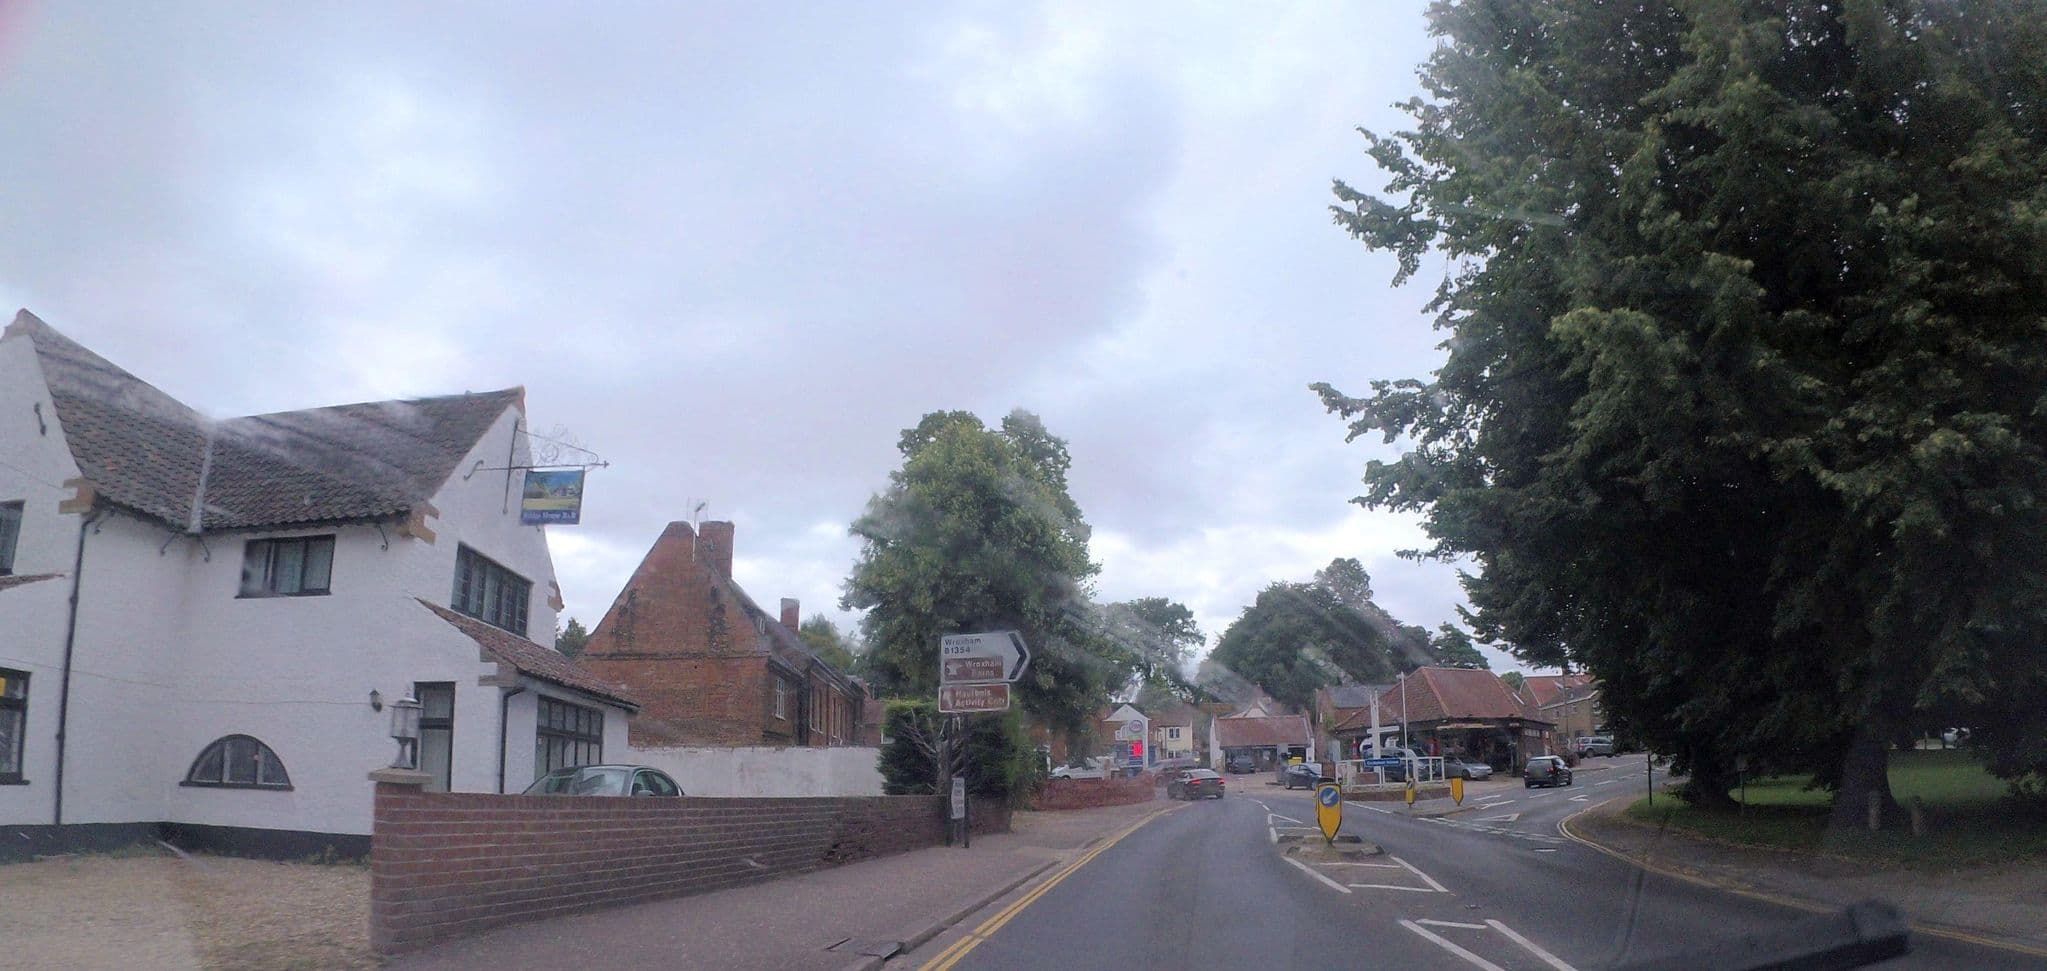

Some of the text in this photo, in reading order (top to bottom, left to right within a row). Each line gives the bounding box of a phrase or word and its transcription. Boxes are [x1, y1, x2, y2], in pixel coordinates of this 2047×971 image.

[944, 638, 982, 646] Wroxham
[944, 646, 971, 654] B1354
[965, 659, 1002, 668] Wroxham
